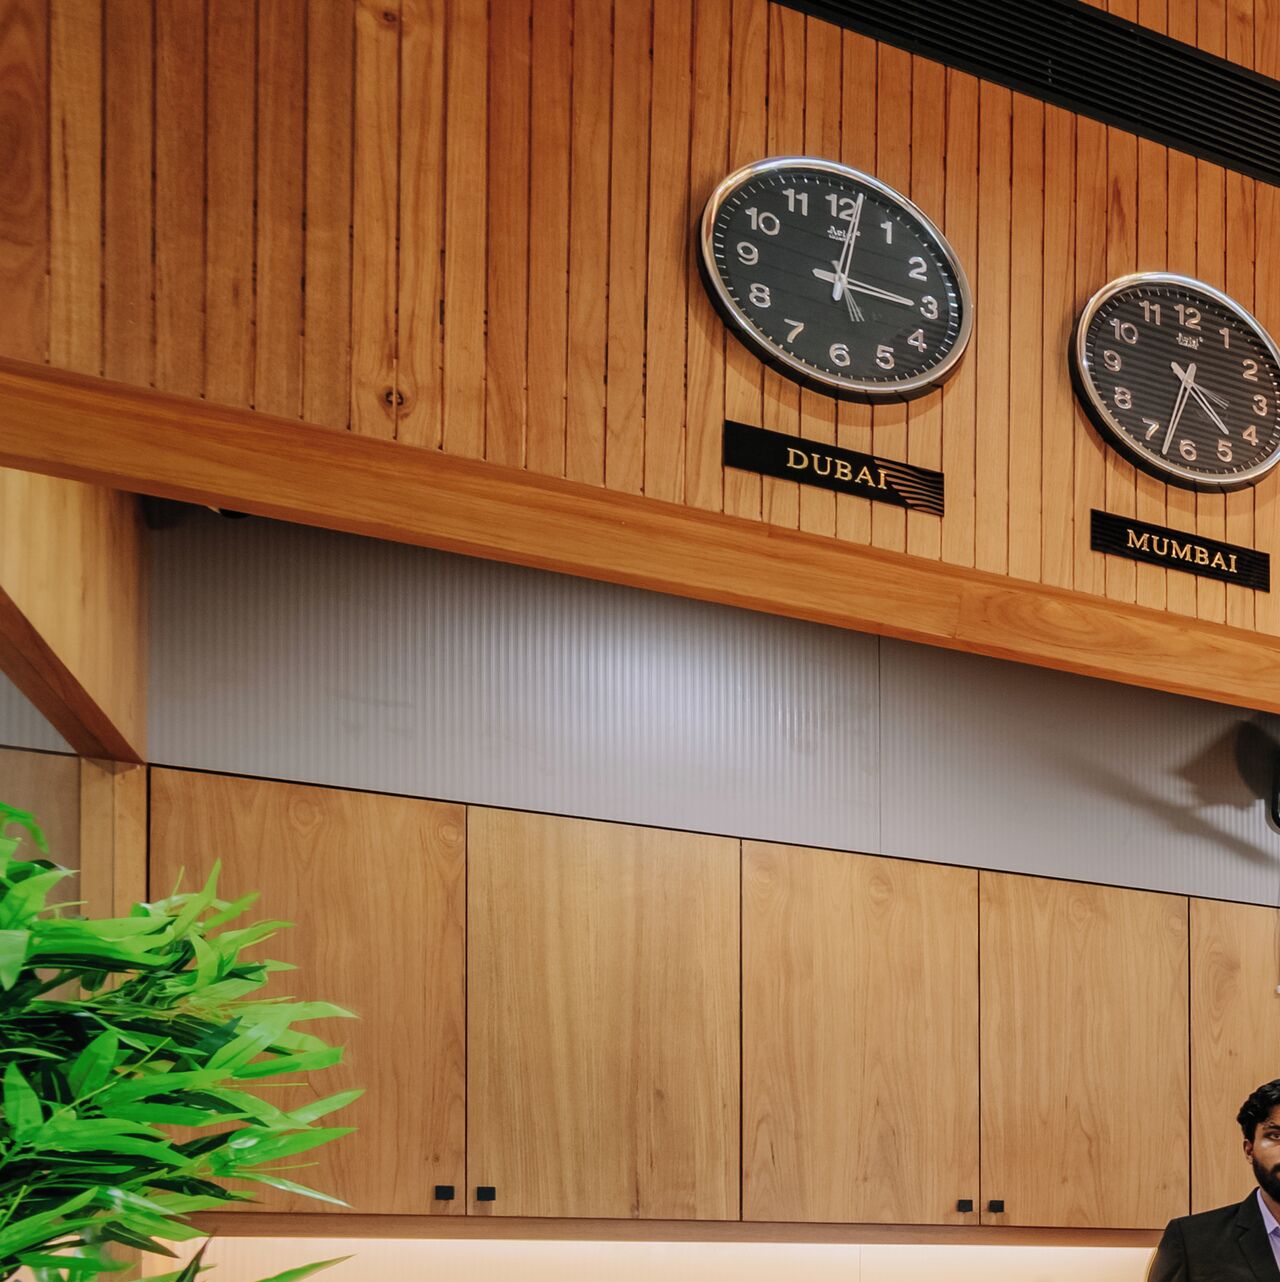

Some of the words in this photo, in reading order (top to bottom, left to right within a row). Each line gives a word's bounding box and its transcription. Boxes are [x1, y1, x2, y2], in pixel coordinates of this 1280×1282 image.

[782, 189, 808, 216] 11
[825, 194, 856, 221] 12
[745, 207, 780, 236] 10
[881, 222, 892, 243] 1
[737, 242, 758, 265] 9
[909, 257, 927, 281] 2
[749, 283, 771, 307] 8
[920, 297, 938, 320] 3
[1139, 301, 1160, 325] 11
[1174, 304, 1201, 330] 12
[784, 319, 804, 343] 7
[907, 329, 927, 352] 4
[1110, 319, 1138, 344] 10
[1220, 328, 1229, 348] 1
[829, 344, 850, 367] 6
[876, 345, 894, 369] 5
[1103, 350, 1121, 372] 9
[1243, 359, 1258, 381] 2
[1114, 387, 1132, 409] 8
[1252, 395, 1268, 416] 3
[1141, 418, 1159, 440] 7
[1243, 425, 1258, 445] 4
[1180, 440, 1197, 460] 6
[1217, 440, 1233, 462] 5
[787, 448, 890, 490] DUBAI
[1127, 529, 1238, 573] MUMBAI
